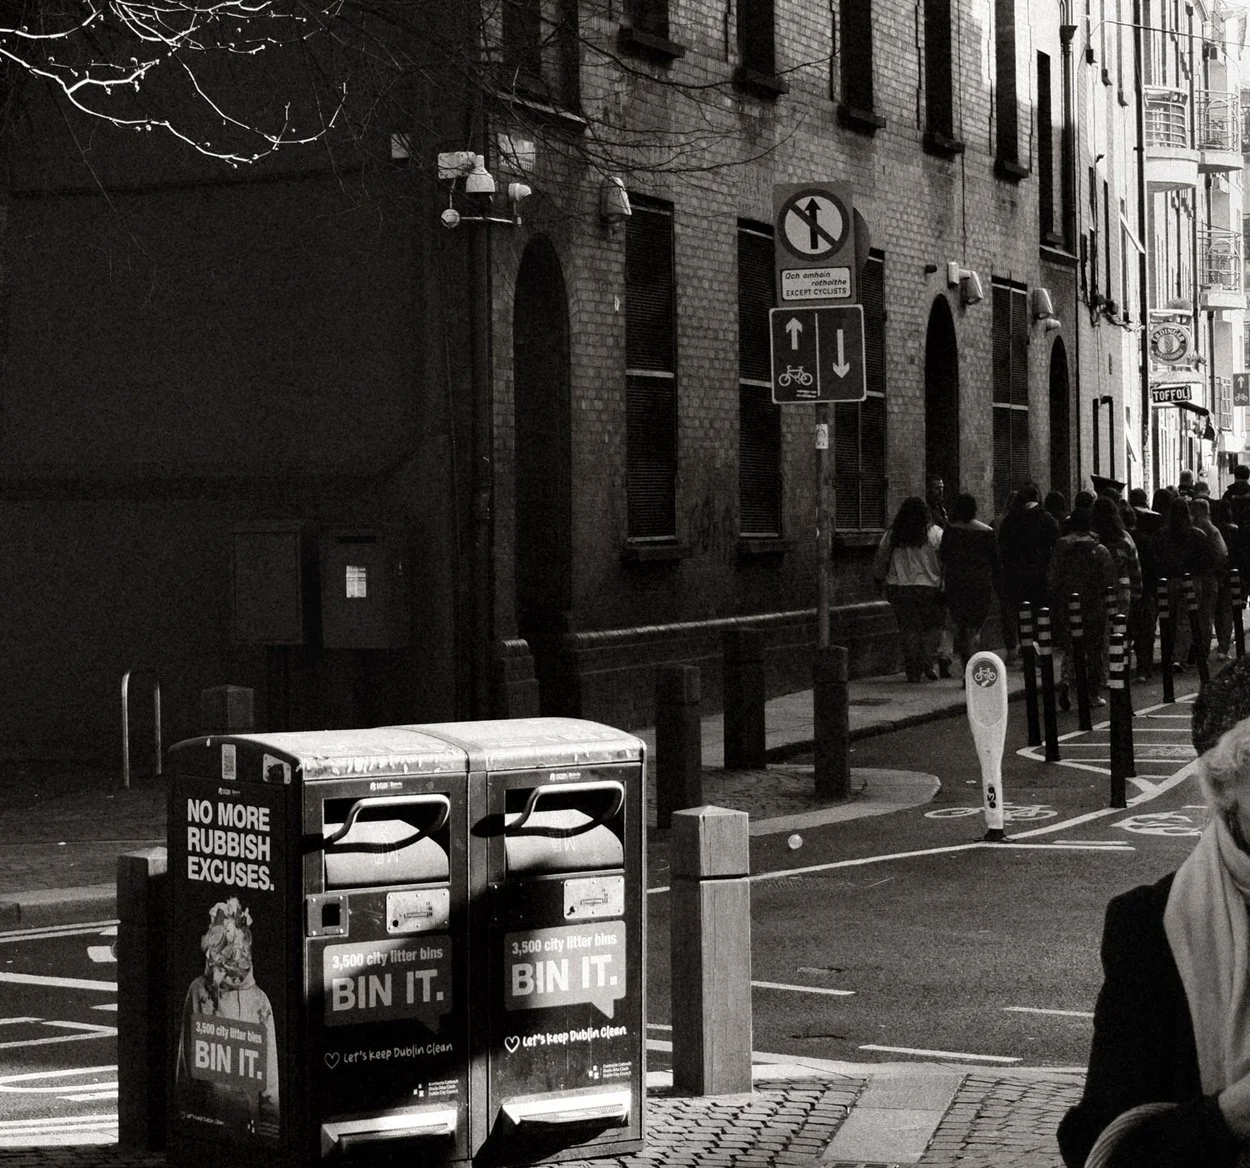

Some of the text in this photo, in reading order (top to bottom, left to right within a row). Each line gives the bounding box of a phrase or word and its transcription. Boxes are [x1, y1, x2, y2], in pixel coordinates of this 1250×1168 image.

[786, 287, 847, 297] EXCEPT CYCLISTS
[1152, 327, 1186, 343] ERDINGER
[187, 798, 270, 832] NO MORE
[187, 826, 271, 862] RUBBISH
[187, 855, 275, 891] EXCUSES.
[512, 932, 618, 957] 3,500 city litter bins
[332, 947, 443, 971] 3,500 city litter bins
[512, 954, 618, 997] BIN IT.
[332, 969, 444, 1011] BIN IT.
[196, 1021, 262, 1044] 3,500 city litter bins
[522, 1034, 546, 1047] Let's
[569, 1028, 600, 1042] Dublin
[195, 1040, 262, 1080] BIN IT.
[343, 1050, 367, 1063] Let's
[394, 1045, 425, 1059] Dublin
